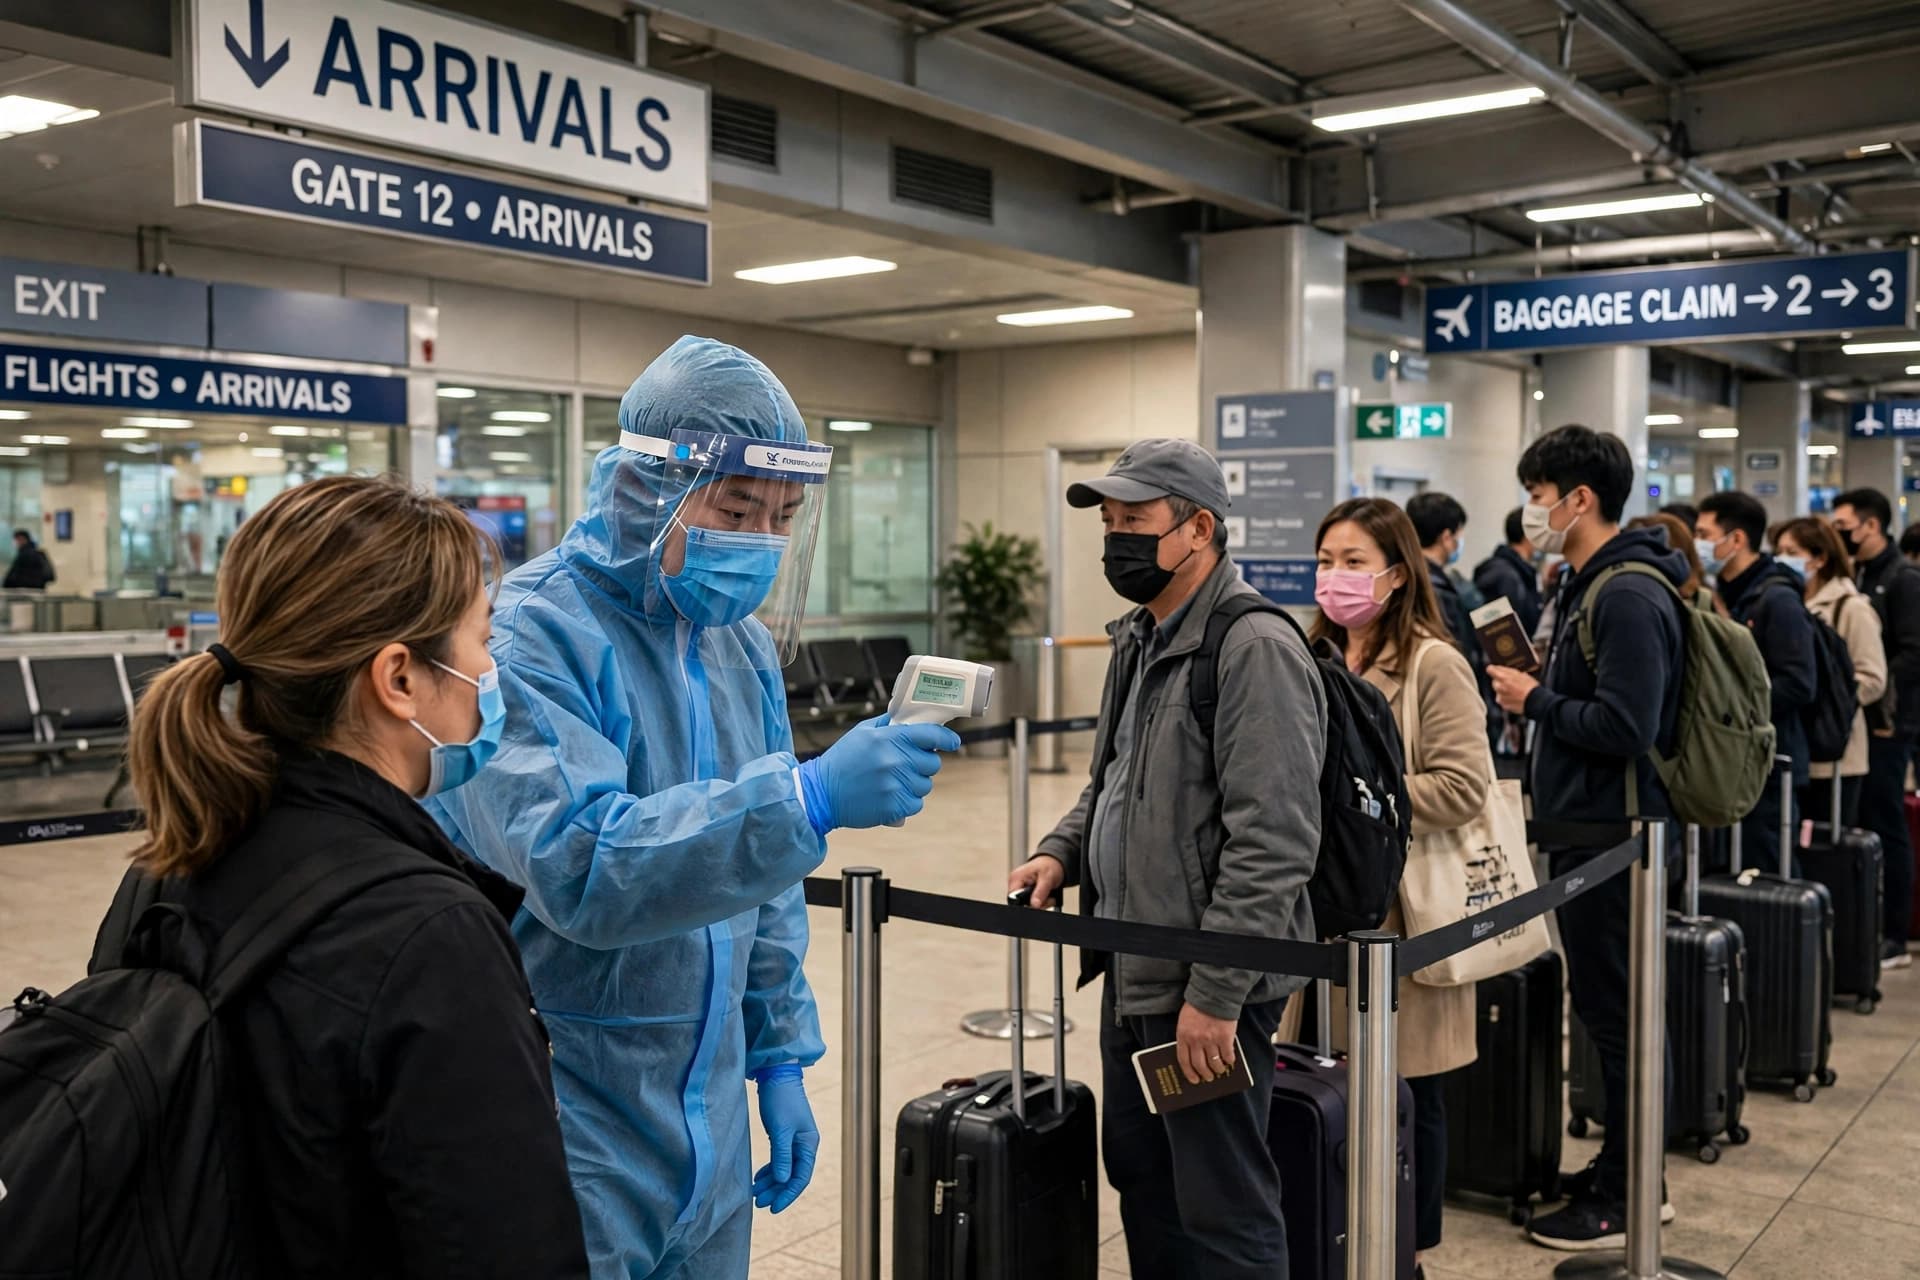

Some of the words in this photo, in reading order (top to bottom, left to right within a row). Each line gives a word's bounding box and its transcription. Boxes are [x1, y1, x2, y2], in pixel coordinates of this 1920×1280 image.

[313, 16, 672, 172] ARRIVALS
[291, 158, 402, 218] GATE
[413, 180, 454, 227] 12
[491, 195, 654, 261] ARRIVALS
[15, 275, 106, 321] EXIT
[1494, 290, 1634, 333] BAGGAGE
[1639, 283, 1737, 323] CLAIM
[1786, 274, 1812, 316] 2
[1866, 268, 1894, 311] 3
[5, 355, 160, 400] FLIGHTS
[196, 371, 352, 414] ARRIVALS
